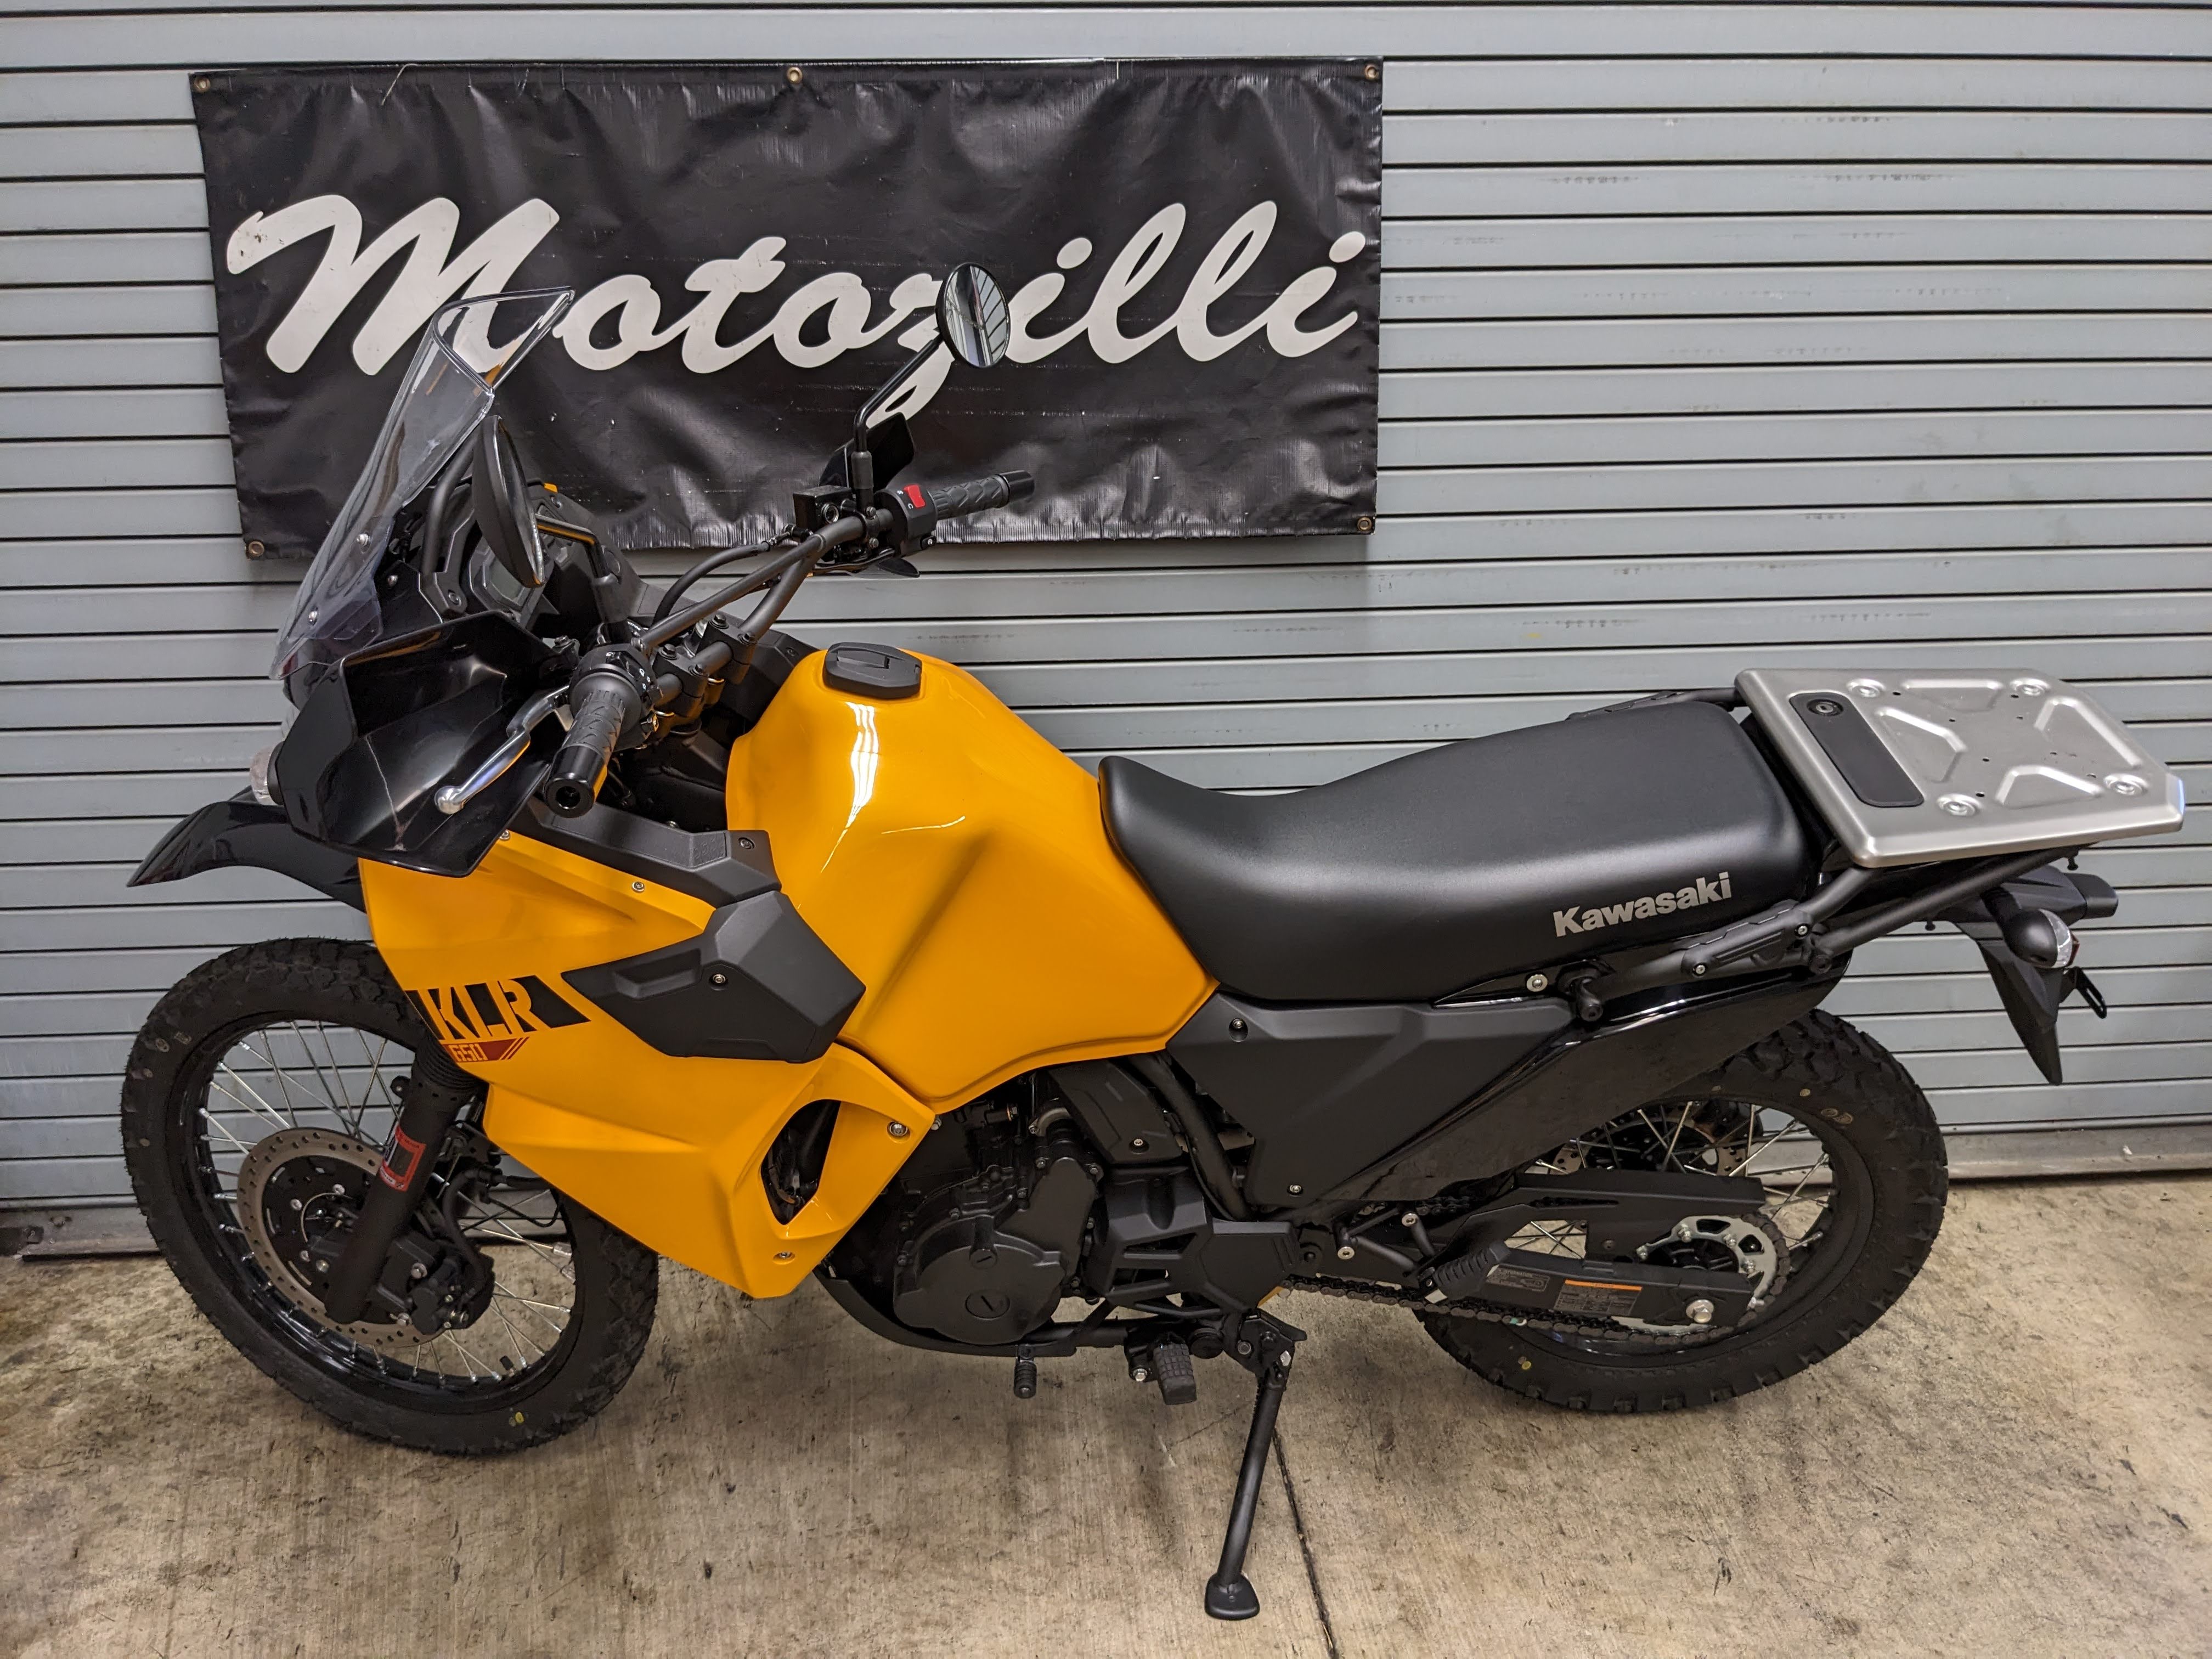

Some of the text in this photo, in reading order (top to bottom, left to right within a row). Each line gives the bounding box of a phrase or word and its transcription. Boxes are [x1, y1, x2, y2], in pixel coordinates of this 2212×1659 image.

[1553, 871, 1733, 938] Kawasaki
[416, 978, 553, 1041] KLR
[448, 1043, 489, 1062] 650
